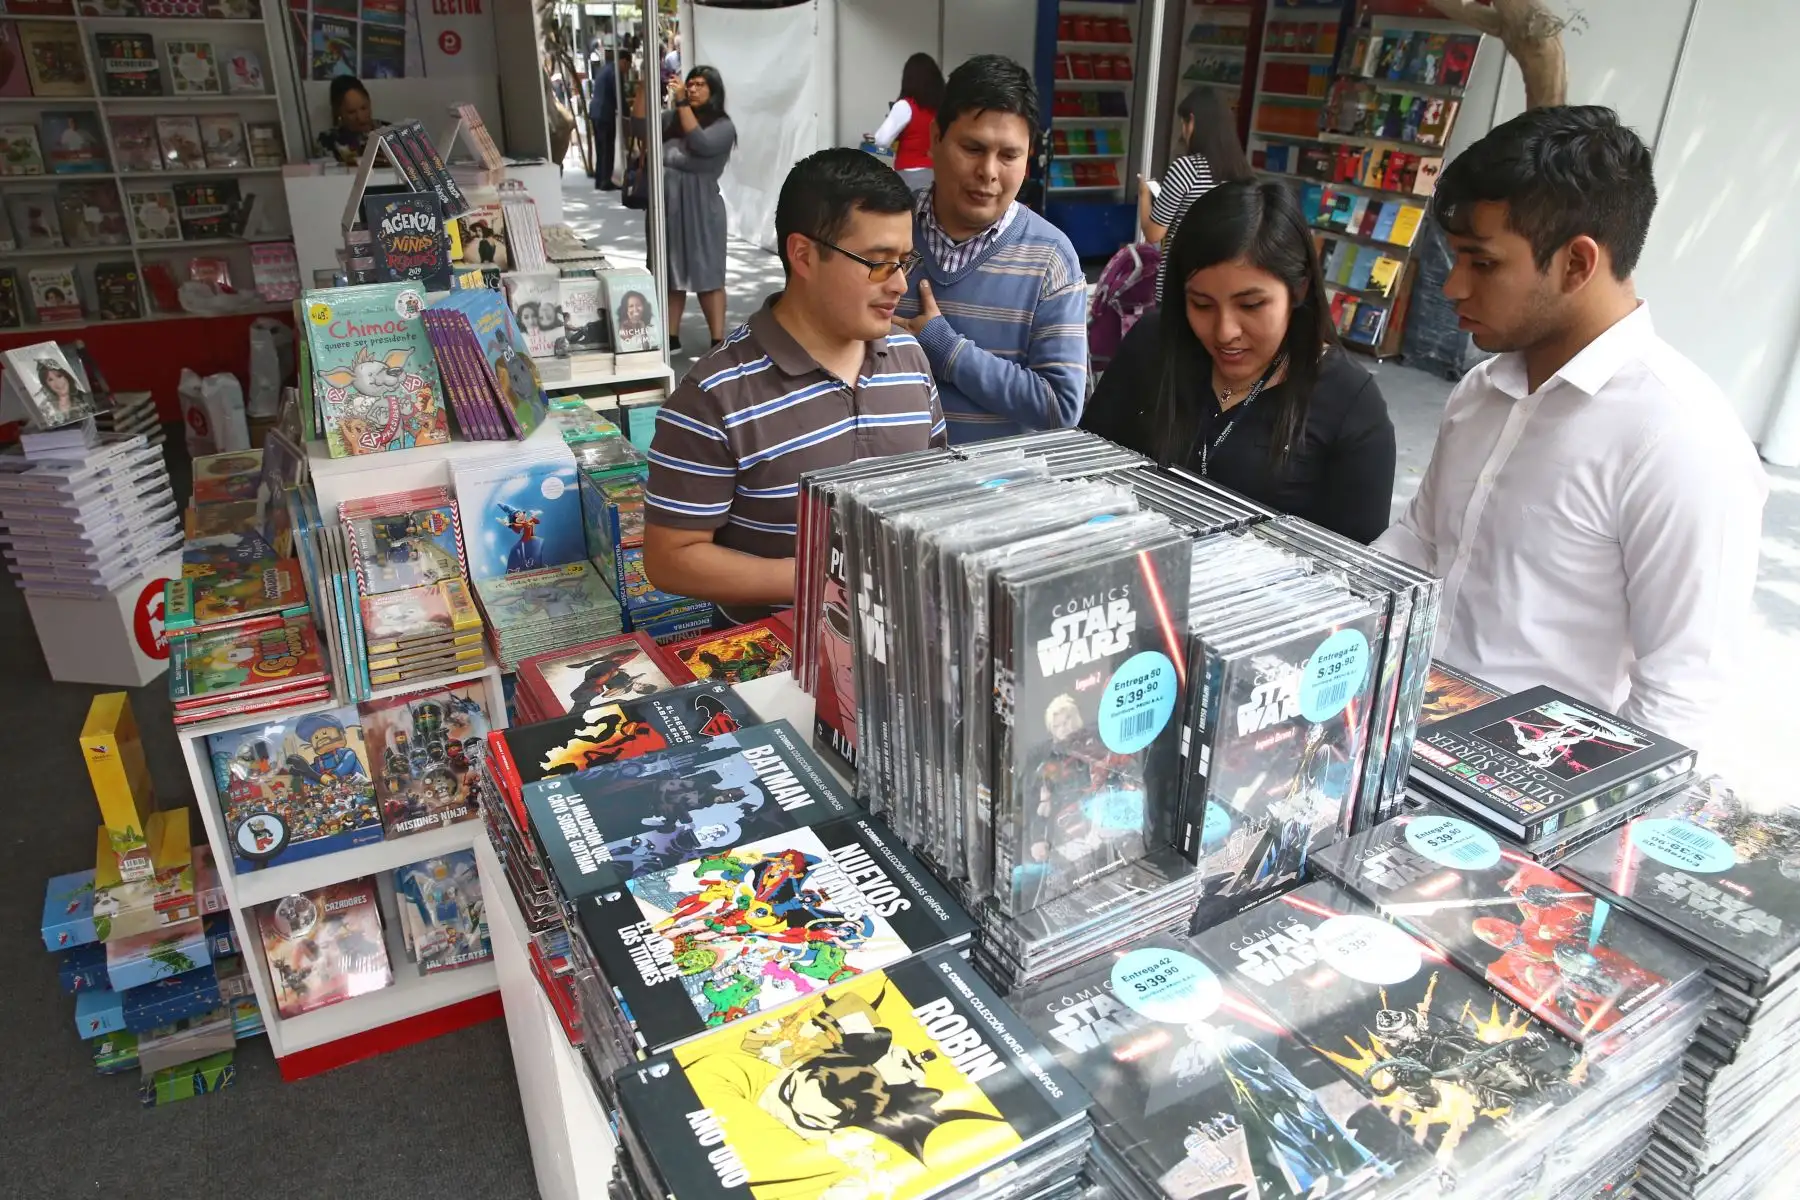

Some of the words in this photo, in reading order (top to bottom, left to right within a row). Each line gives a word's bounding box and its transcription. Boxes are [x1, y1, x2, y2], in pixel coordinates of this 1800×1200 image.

[382, 214, 436, 234] AGENDA
[329, 319, 408, 340] Chimoc
[324, 340, 350, 351] quiere
[352, 339, 368, 348] ser
[370, 334, 416, 348] presidente
[615, 543, 624, 580] ENCUENTRA
[673, 618, 709, 629] ENCUENTRA
[1037, 598, 1136, 651] STAR
[1038, 622, 1136, 677] WARS
[1318, 649, 1348, 664] Entrega
[1114, 674, 1149, 691] Entrega
[1150, 668, 1161, 678] 50
[1317, 656, 1355, 678] S/39.90
[1116, 682, 1158, 708] S/39.90
[1201, 684, 1210, 707] IMPERIO
[653, 700, 683, 744] CABALLERO
[666, 705, 675, 714] EL
[1198, 707, 1207, 729] OSCURO
[774, 728, 783, 737] DC
[778, 734, 795, 751] COMICS
[832, 728, 838, 750] A
[840, 736, 852, 763] LA
[1427, 732, 1499, 770] SURFER
[792, 749, 812, 772] COLECCIÓN
[1420, 756, 1445, 773] NOVELAS
[1468, 740, 1548, 782] ORIGENES
[740, 744, 815, 812] BATMAN
[808, 769, 828, 790] NOVELAS
[1498, 768, 1564, 805] SILVER
[566, 794, 584, 806] LA
[823, 788, 844, 810] GRÁFICAS
[1484, 790, 1519, 813] COLECCIÓN
[396, 813, 439, 834] MISIONES
[440, 806, 468, 824] NINJA
[570, 804, 605, 847] MALDICIÓN
[1414, 826, 1444, 839] Entrega
[556, 814, 580, 841] SOBRE
[568, 838, 598, 875] GOTHAM
[592, 844, 614, 864] QUE
[1354, 836, 1405, 861] CÓMIC
[1651, 836, 1706, 861] S/39.90
[1660, 847, 1700, 867] Entrega
[829, 842, 912, 917] NUEVOS
[857, 820, 868, 828] DC
[864, 826, 884, 848] COMICS
[880, 846, 908, 874] COLECCIÓN
[904, 871, 928, 896] NOVELAS
[923, 895, 950, 921] GRÁFICAS
[806, 860, 875, 921] TITANES
[1654, 872, 1770, 918] WARS
[324, 894, 368, 913] CAZADORES
[1658, 882, 1782, 937] STAR
[618, 925, 642, 946] LOS
[636, 920, 652, 934] EL
[642, 932, 674, 966] ALBOR
[1236, 924, 1314, 968] STAR
[628, 944, 664, 987] TITANES
[660, 964, 684, 982] DE
[1121, 964, 1160, 982] Entrega
[1159, 957, 1172, 966] 42
[1236, 944, 1318, 986] WAR
[1134, 966, 1179, 992] S/39.90
[1046, 980, 1114, 1012] CÓMIC
[1048, 993, 1126, 1034] STA
[911, 996, 1006, 1084] ROBIN
[939, 962, 952, 974] DC
[948, 970, 975, 999] COMICS
[970, 997, 1006, 1038] COLECCIÓN
[1001, 1032, 1035, 1067] NOVELAS
[1028, 1062, 1064, 1099] GRÁFICAS
[685, 1108, 728, 1146] AÑO
[708, 1144, 750, 1189] UNO
